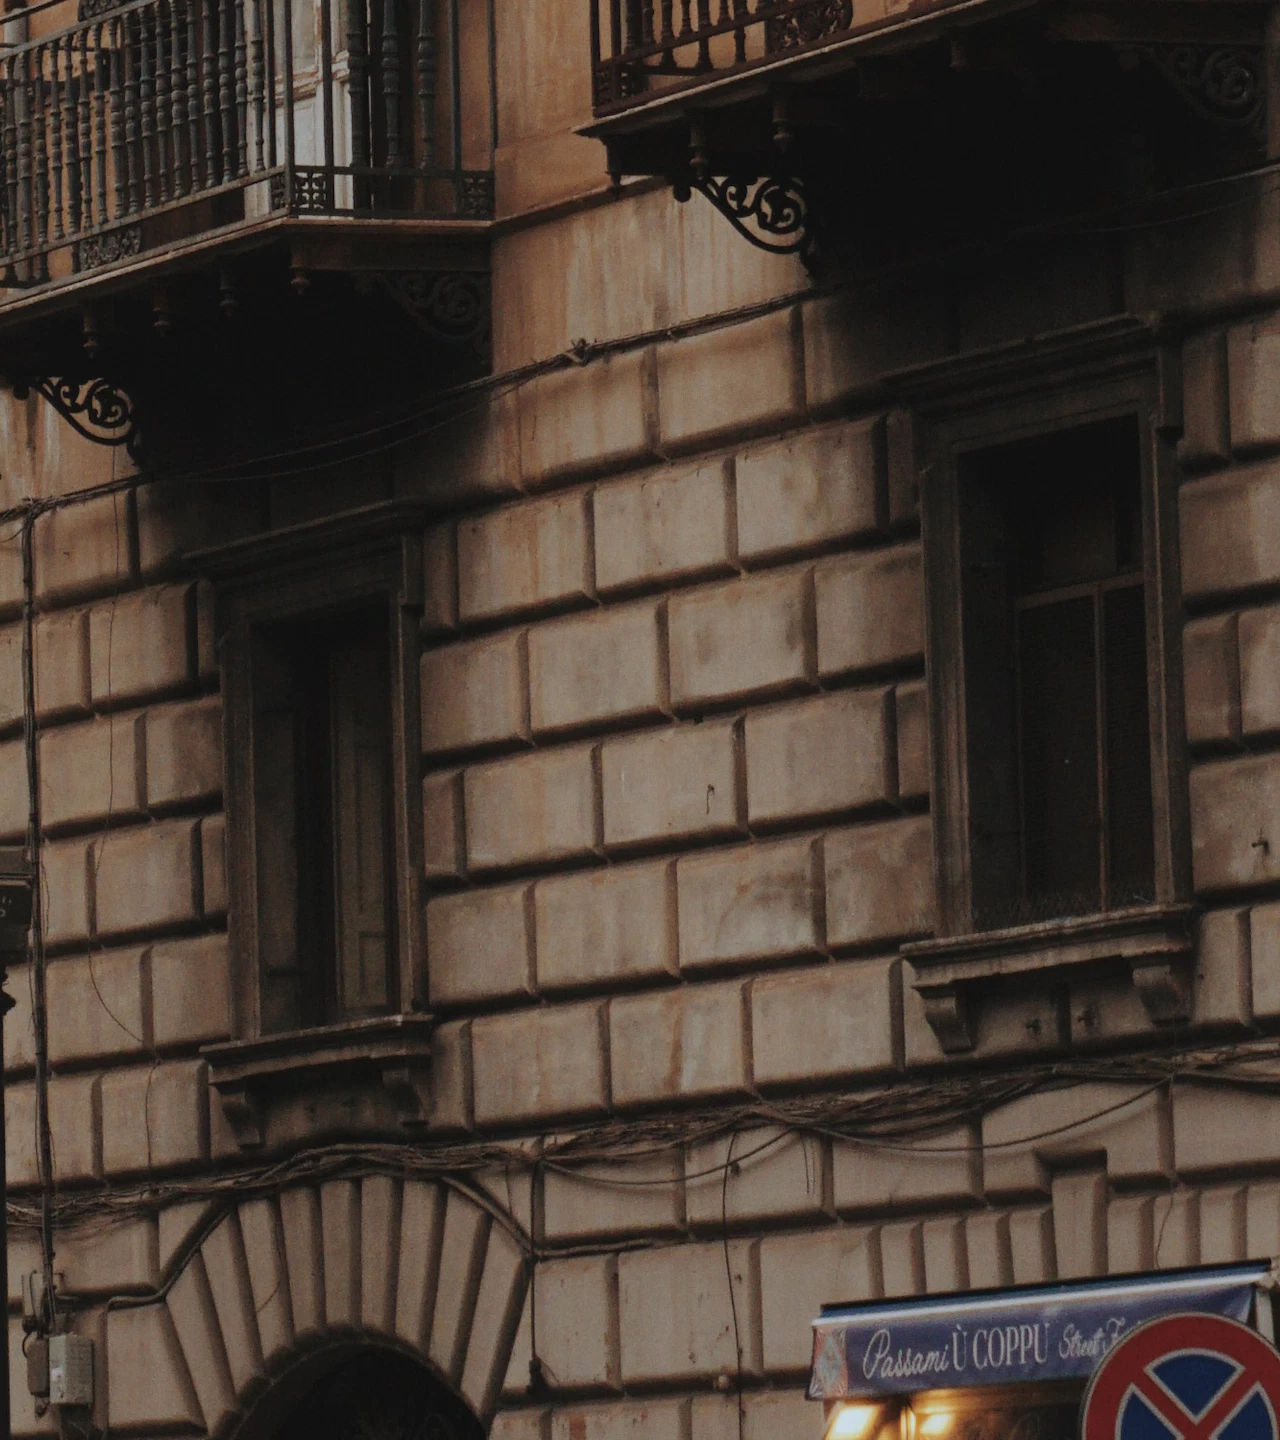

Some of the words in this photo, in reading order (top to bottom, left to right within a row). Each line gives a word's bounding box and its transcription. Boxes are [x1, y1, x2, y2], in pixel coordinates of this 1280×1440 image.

[862, 1329, 949, 1380] Passami
[973, 1323, 1049, 1368] COPPU
[1059, 1323, 1104, 1360] Street
